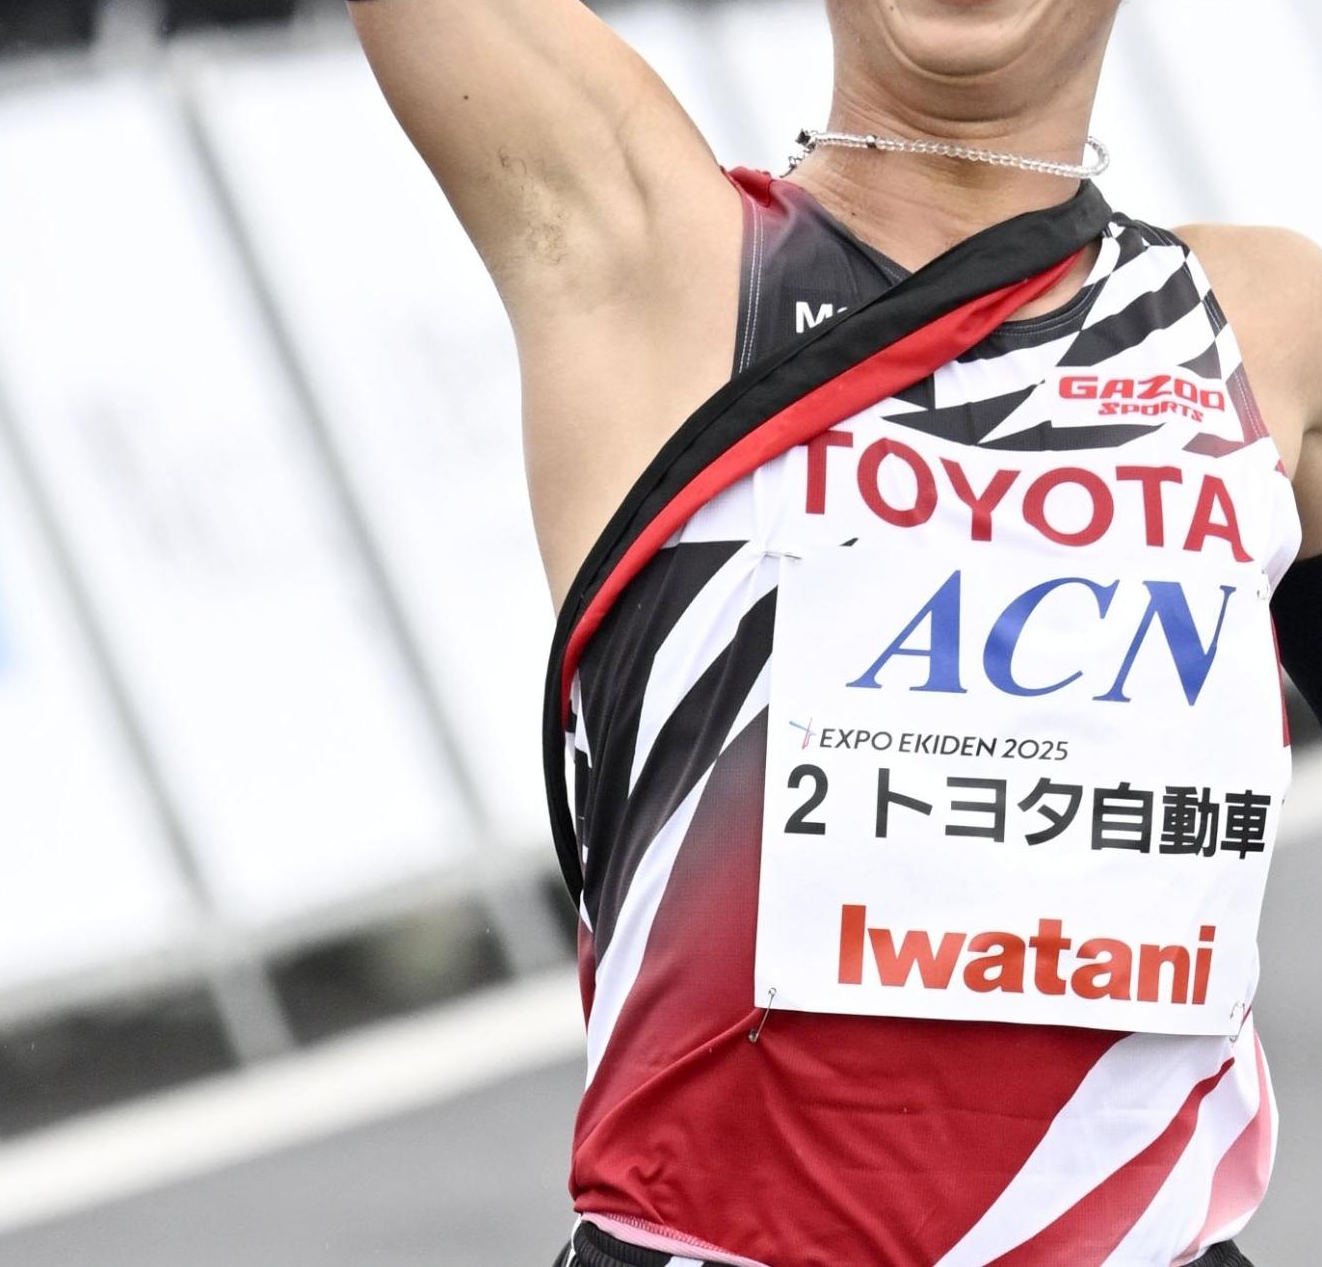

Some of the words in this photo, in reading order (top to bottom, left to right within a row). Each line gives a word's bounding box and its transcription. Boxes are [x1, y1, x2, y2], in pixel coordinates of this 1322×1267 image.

[795, 301, 848, 334] M
[1058, 374, 1226, 413] GAZOO
[1098, 400, 1205, 423] SPORTS
[797, 429, 1254, 563] TOYOTA
[845, 569, 1237, 708] ACN
[819, 728, 893, 751] EXPO
[898, 733, 998, 758] EKIDEN
[1001, 738, 1069, 761] 2025
[783, 763, 829, 836] 2
[875, 767, 1273, 860] トヨタ自動車
[837, 904, 1217, 1006] Iwatani
